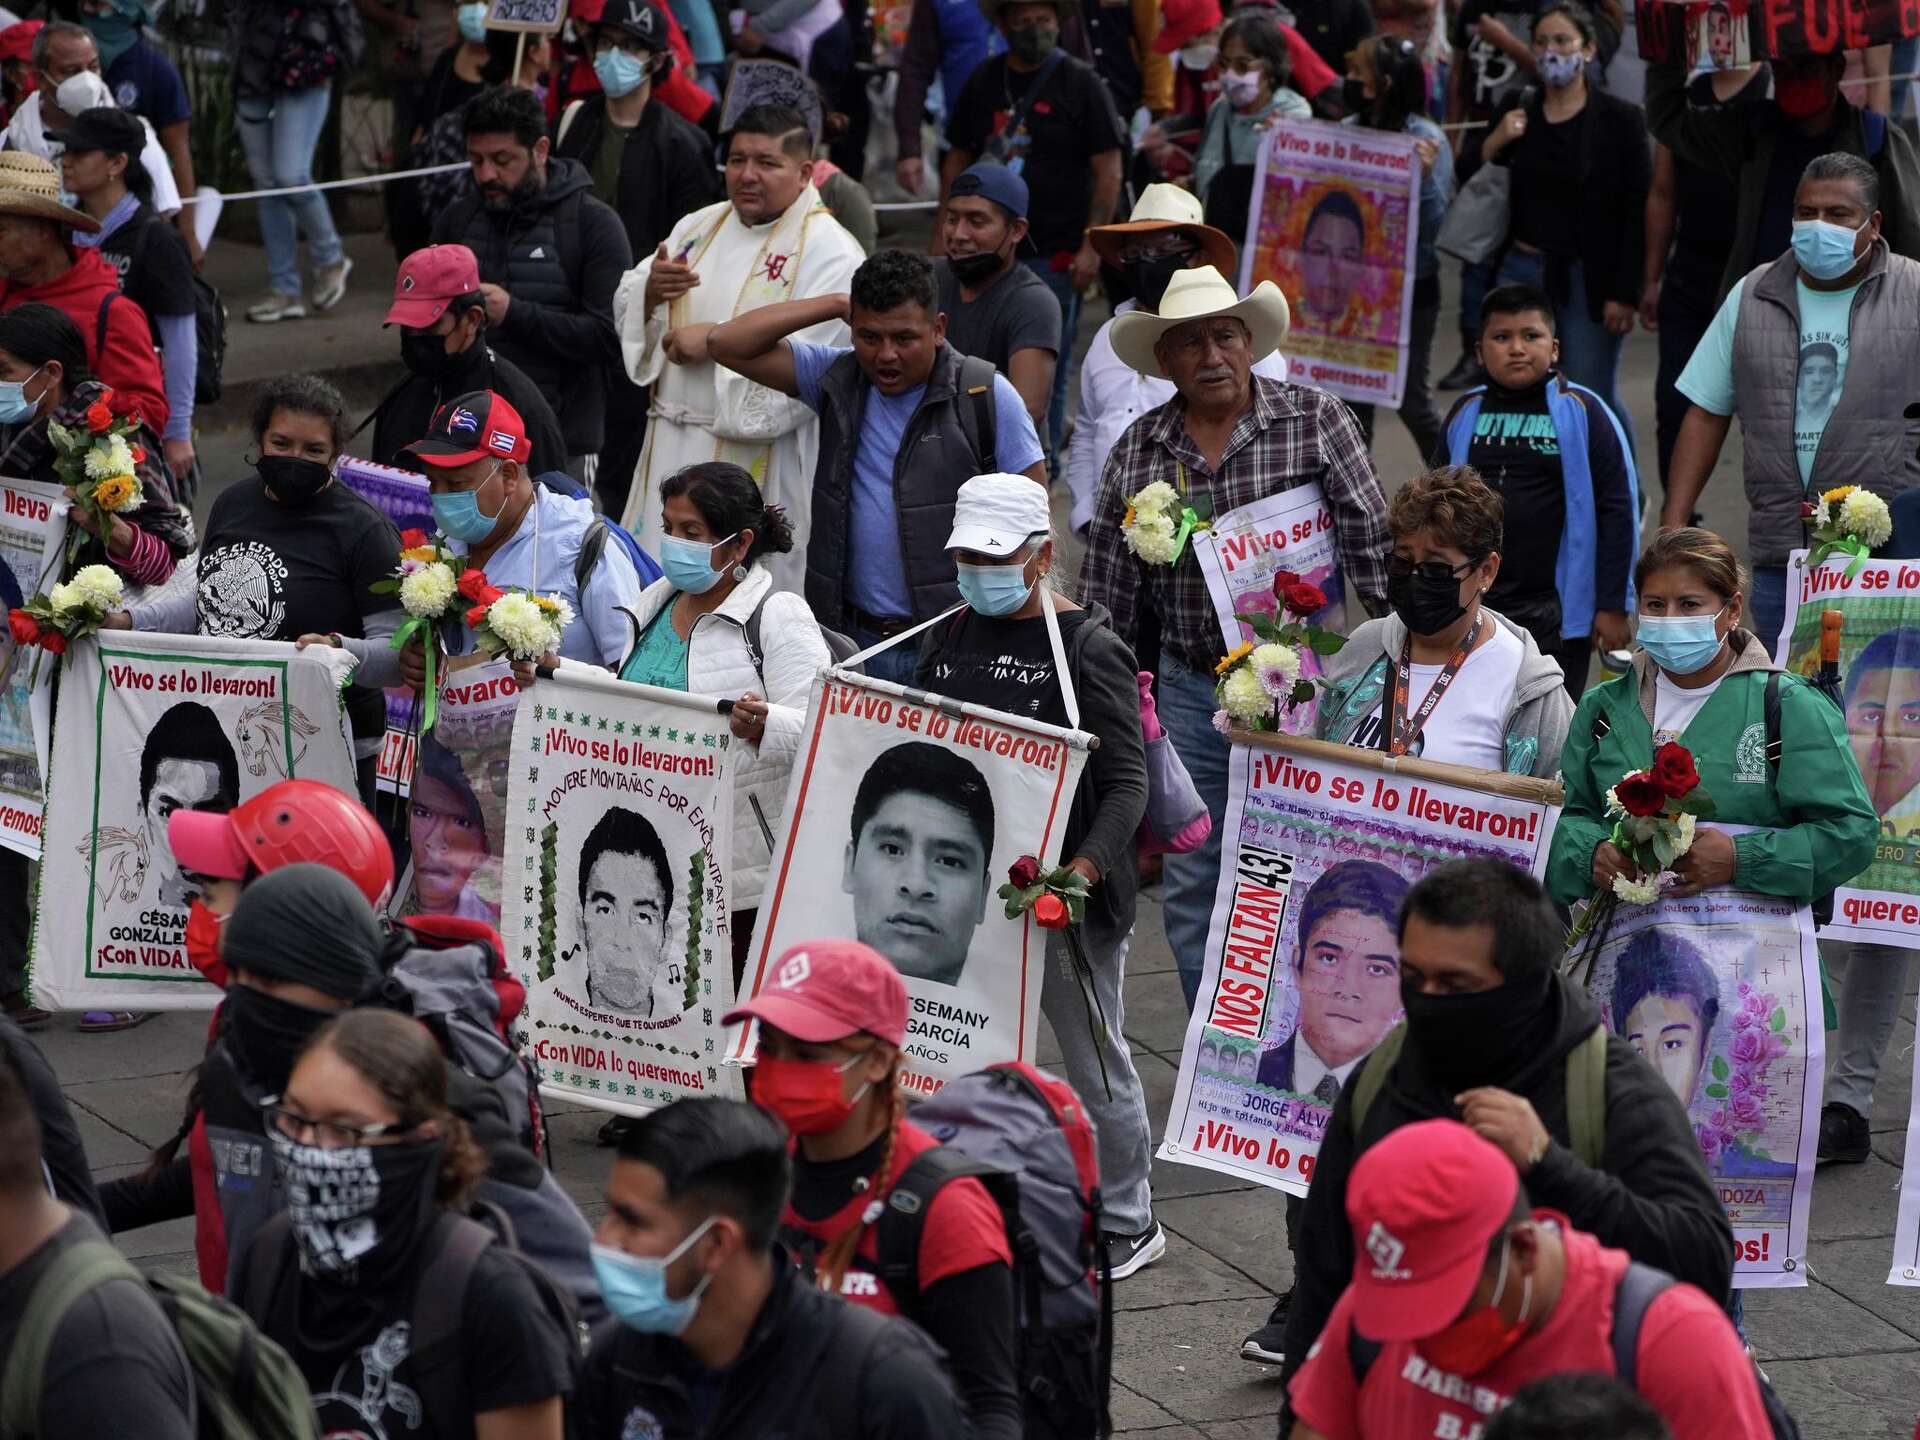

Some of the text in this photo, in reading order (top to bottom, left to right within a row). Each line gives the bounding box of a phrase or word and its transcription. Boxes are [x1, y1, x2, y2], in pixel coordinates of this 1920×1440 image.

[1314, 141, 1331, 157] se
[1334, 140, 1346, 160] lo
[1350, 143, 1411, 169] llevaron!
[1816, 331, 1831, 342] SIN
[1289, 357, 1388, 390] lo queremos!
[1221, 508, 1333, 572] ¡Vivo se lo
[231, 542, 246, 553] EL
[248, 541, 289, 578] ESTADO
[265, 563, 283, 594] TODOS
[1803, 565, 1920, 602] ¡Vivo se lo
[108, 665, 276, 698] ¡Vivo se lo llevaron!
[829, 686, 1060, 772] ¡Vivo se lo llevaron!
[545, 728, 714, 777] ¡Vivo se lo llevaron!
[1252, 795, 1265, 808] Yo,
[1288, 803, 1315, 818] Nimmo,
[1253, 752, 1539, 842] ¡Vivo se lo llevaron!
[542, 767, 729, 937] MOVERE MONTAÑAS POR ENCONTRARTE
[1237, 843, 1295, 889] 43!
[140, 909, 188, 929] CÉSAR
[1664, 903, 1700, 914] quiero
[1705, 903, 1732, 913] saber
[1738, 901, 1766, 914] dónde
[1770, 904, 1793, 917] está
[1225, 883, 1283, 979] FALTAN
[98, 945, 136, 968] ¡Con
[140, 946, 186, 970] VIDA
[553, 987, 682, 1031] NUNCA ESPERES QUE TE OLVIDEMOS
[1212, 978, 1264, 1037] NOS
[905, 1018, 971, 1049] GARCÍA
[534, 1039, 705, 1090] ¡Con VIDA lo queremos!
[905, 1044, 950, 1064] AÑOS
[1198, 1100, 1312, 1138] Hijo de Epifanio y Blanca
[1242, 1092, 1290, 1118] JORGE
[1193, 1119, 1260, 1160] ¡Vivo
[1267, 1138, 1291, 1169] lo
